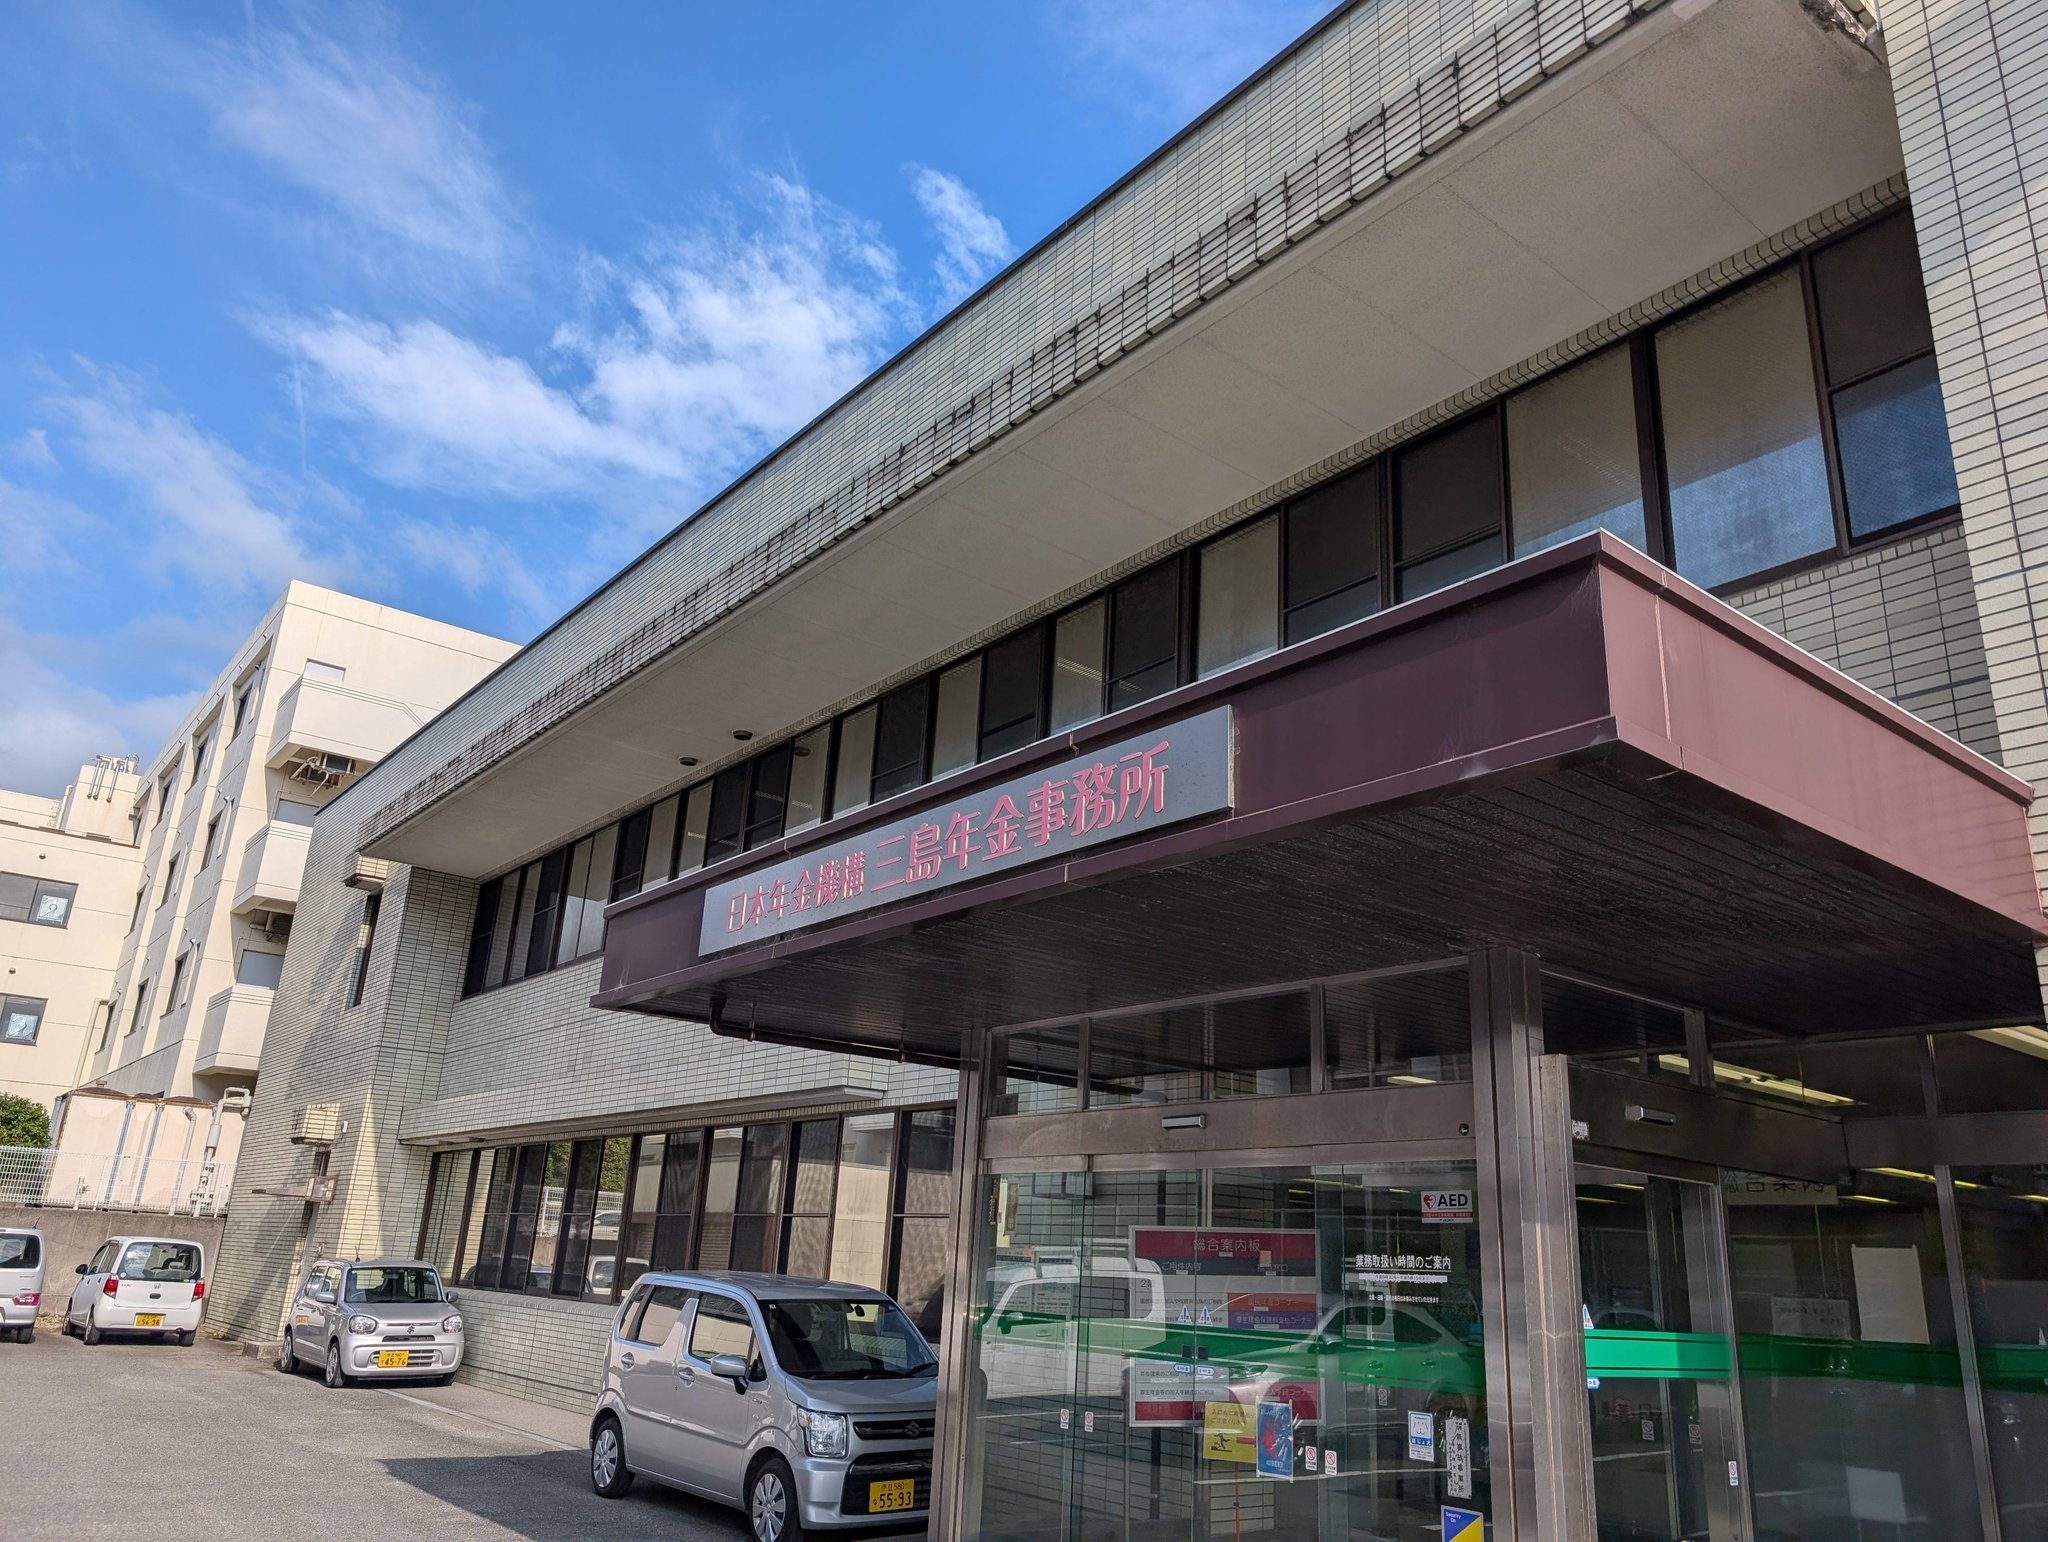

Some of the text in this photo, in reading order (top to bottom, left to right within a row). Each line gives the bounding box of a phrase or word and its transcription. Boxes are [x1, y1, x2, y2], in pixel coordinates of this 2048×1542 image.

[726, 740, 1170, 934] 日本年金機構 三島年金事務所
[1437, 1193, 1469, 1207] AED
[1193, 1238, 1261, 1252] 総合案内板
[1355, 1254, 1452, 1269] 業務取扱い時間のご案内
[384, 1358, 406, 1366] 45-76
[893, 1482, 905, 1490] 580
[879, 1491, 912, 1509] 55-93
